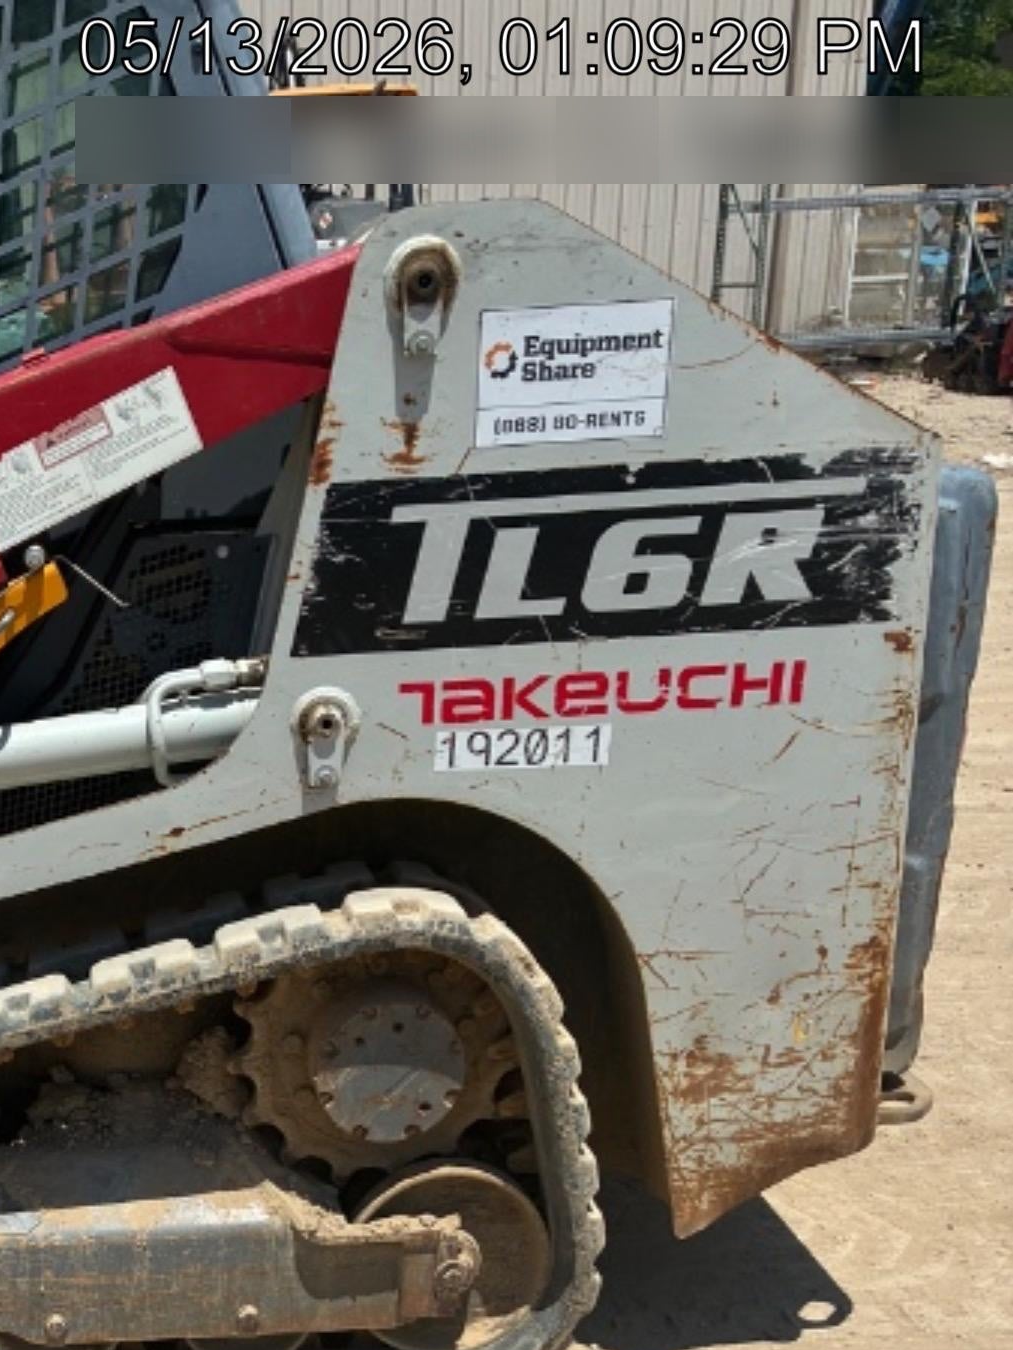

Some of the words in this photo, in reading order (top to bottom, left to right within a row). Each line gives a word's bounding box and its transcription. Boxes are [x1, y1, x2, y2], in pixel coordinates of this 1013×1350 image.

[523, 329, 664, 360] Equipment
[521, 361, 596, 382] Share
[390, 476, 867, 626] TL6R
[441, 725, 603, 769] 192011
